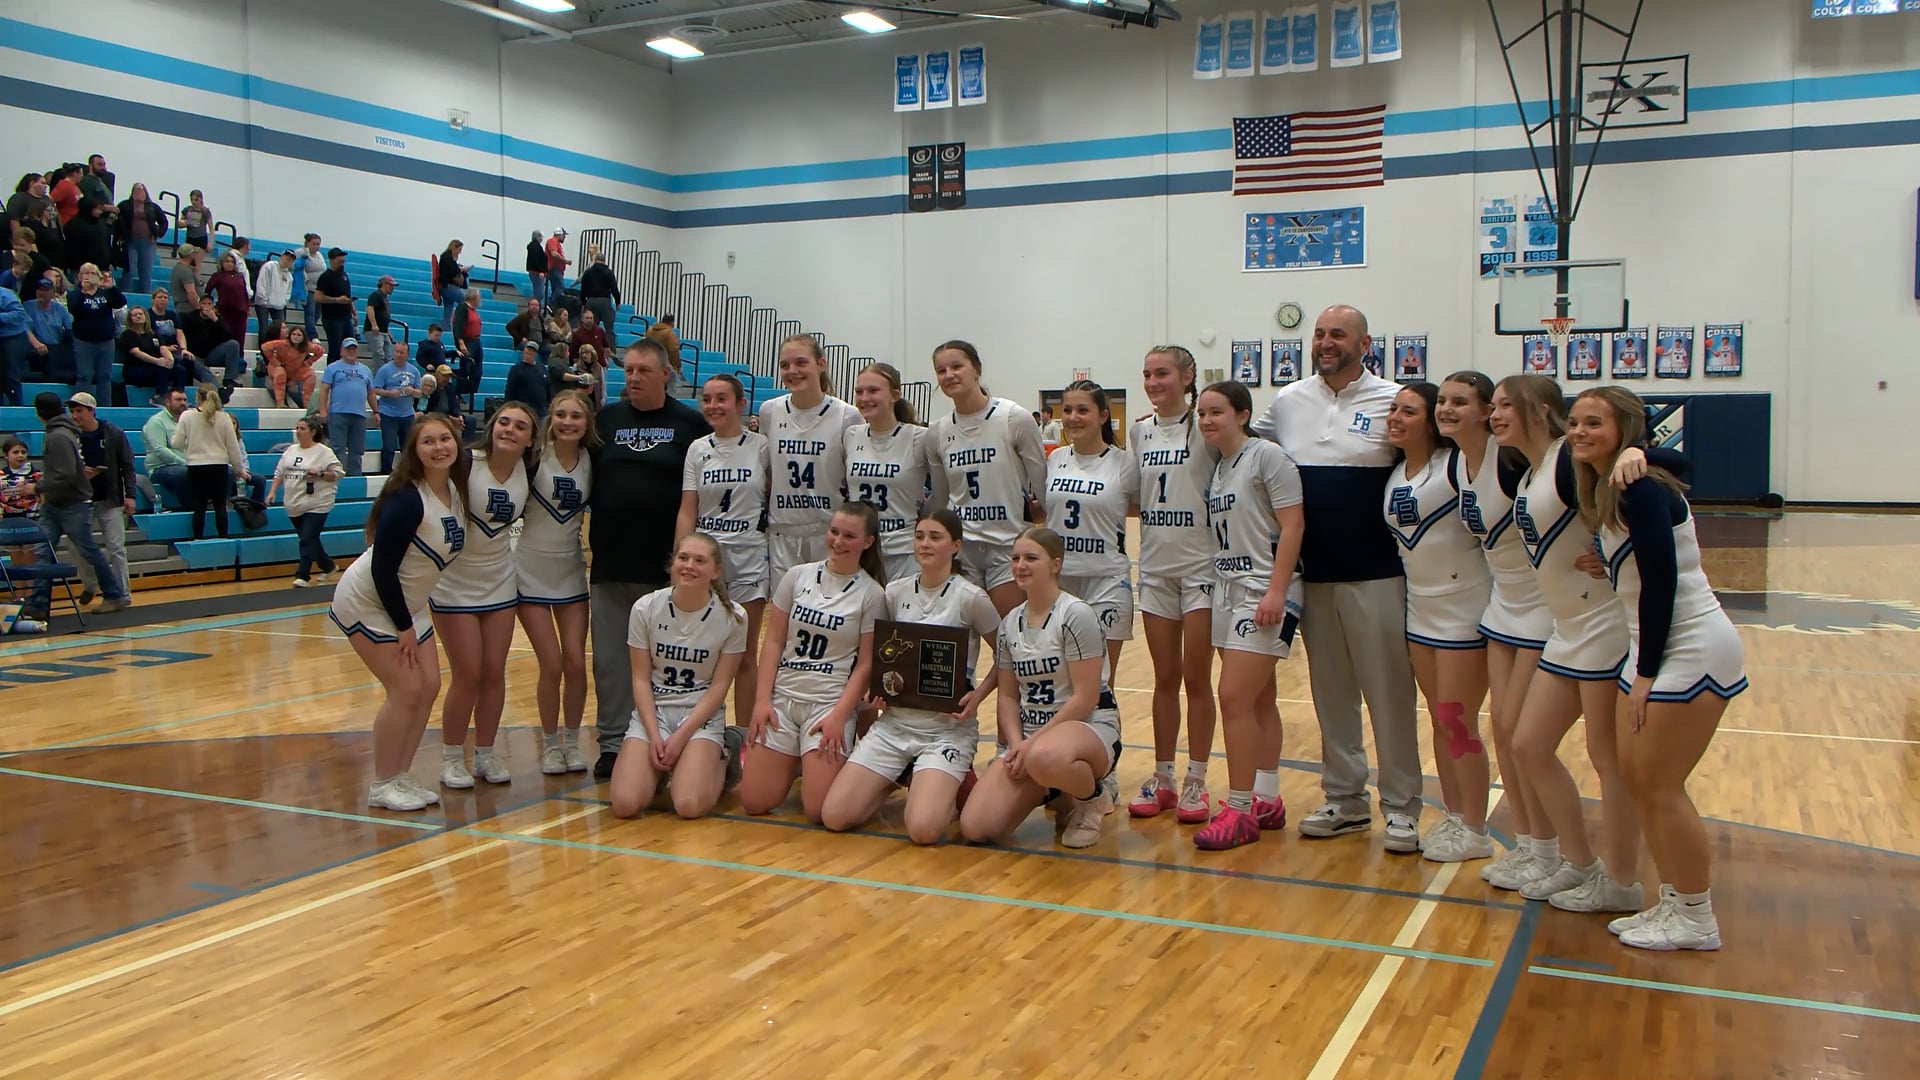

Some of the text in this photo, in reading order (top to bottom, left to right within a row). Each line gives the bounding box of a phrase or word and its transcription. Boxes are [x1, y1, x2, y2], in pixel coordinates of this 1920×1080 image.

[375, 135, 406, 149] VISITORS
[1489, 226, 1508, 249] 3
[1482, 253, 1514, 265] 2018
[1526, 251, 1558, 262] 1999
[1524, 335, 1551, 344] COLT
[1568, 333, 1601, 342] COLTS
[1613, 331, 1647, 341] COLTS
[1658, 331, 1693, 340] COLTS
[1706, 329, 1742, 338] COLTS
[1233, 345, 1261, 353] COLTS
[1272, 343, 1301, 352] COLTS
[1395, 338, 1426, 348] COLTS
[614, 427, 675, 441] PHILIP BARBOUR
[778, 439, 826, 456] PHILIP
[293, 456, 304, 466] P
[949, 448, 996, 468] PHILIP
[1142, 449, 1191, 468] PHILIP
[703, 468, 752, 485] PHILIP
[787, 460, 815, 489] 34
[850, 462, 901, 478] PHILIP
[552, 475, 583, 511] PB
[966, 470, 980, 500] 5
[1050, 478, 1105, 496] PHILIP
[1158, 472, 1168, 504] 1
[486, 488, 516, 523] PB
[719, 488, 733, 513] 4
[776, 494, 831, 509] BARBOUR
[859, 483, 888, 512] 23
[1388, 485, 1421, 527] PB
[1063, 499, 1081, 530] 3
[1461, 489, 1488, 535] PB
[1515, 496, 1541, 545] PB
[440, 515, 465, 555] PB
[1215, 518, 1230, 551] 11
[791, 604, 845, 631] PHILIP
[655, 642, 709, 664] PHILIP
[794, 629, 829, 661] 30
[663, 665, 696, 689] 33
[921, 663, 953, 673] BASKETBALL
[921, 686, 950, 694] CHAMPION
[922, 679, 949, 688] REGIONAL
[1026, 679, 1055, 705] 25
